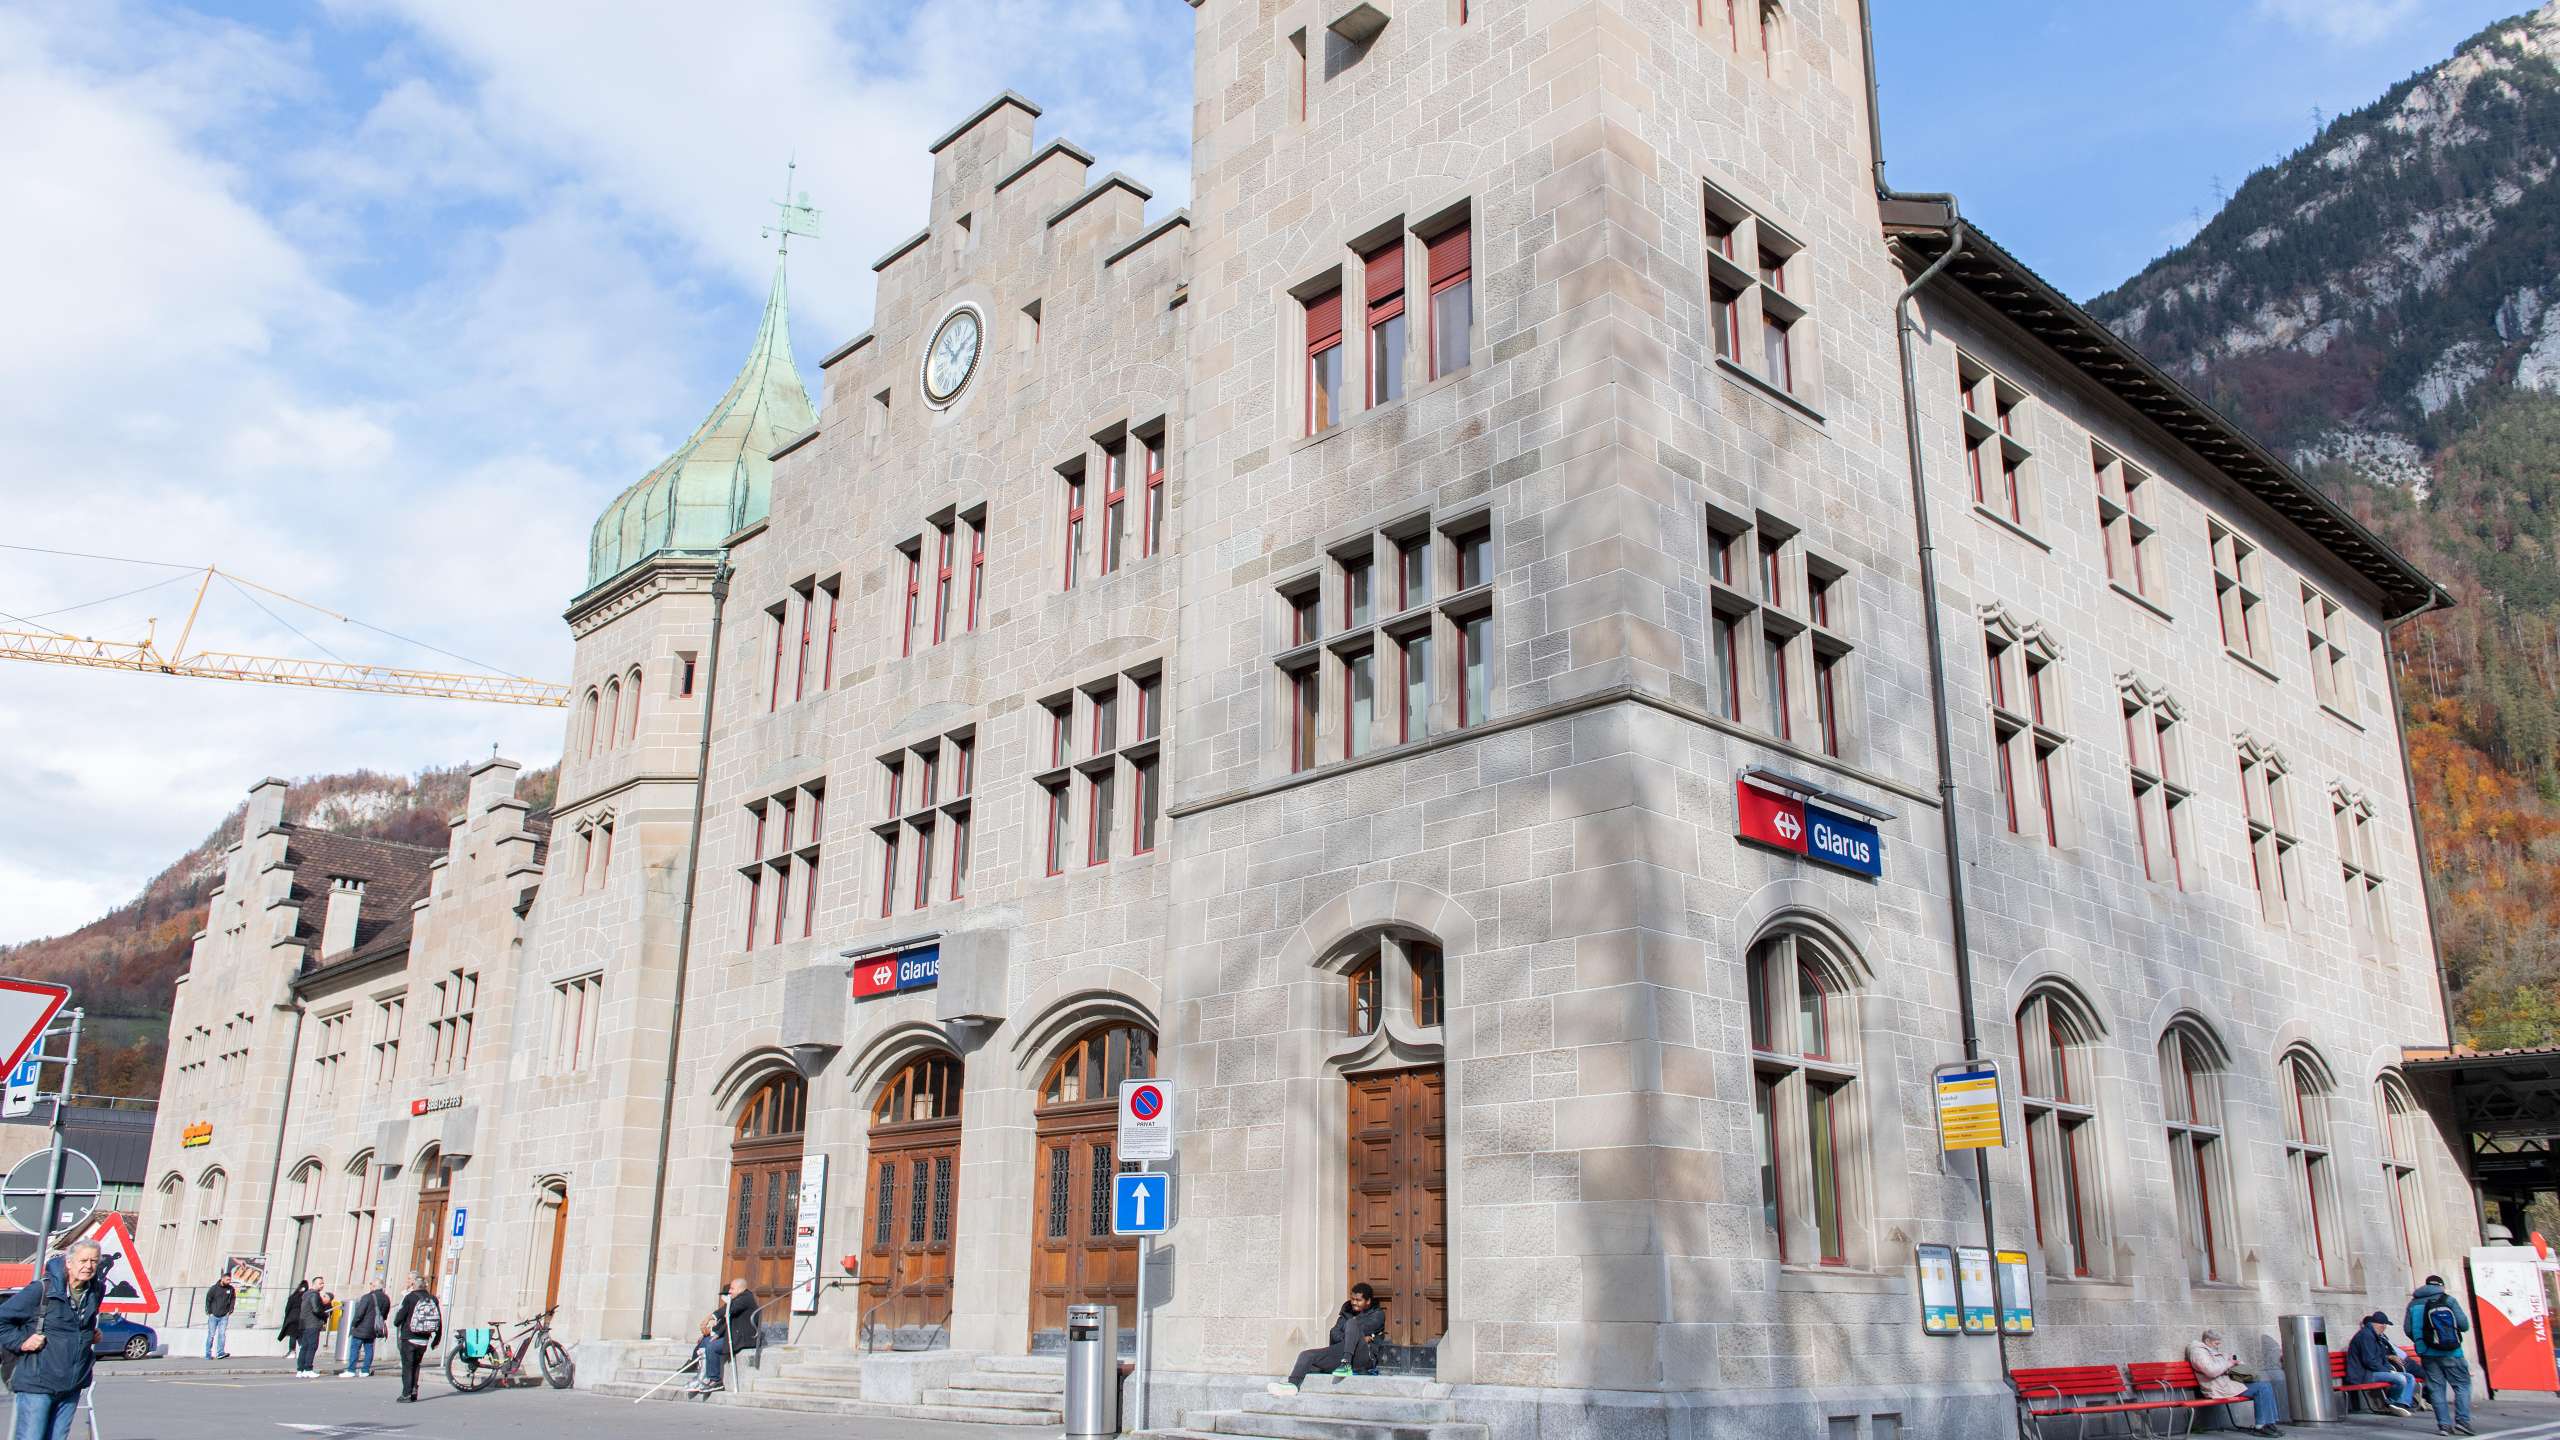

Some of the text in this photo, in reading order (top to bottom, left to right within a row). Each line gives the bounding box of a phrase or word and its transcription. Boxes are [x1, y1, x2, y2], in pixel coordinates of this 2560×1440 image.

[1813, 823, 1870, 863] Glarus
[456, 1212, 465, 1234] P
[2532, 1315, 2547, 1343] TAKE
